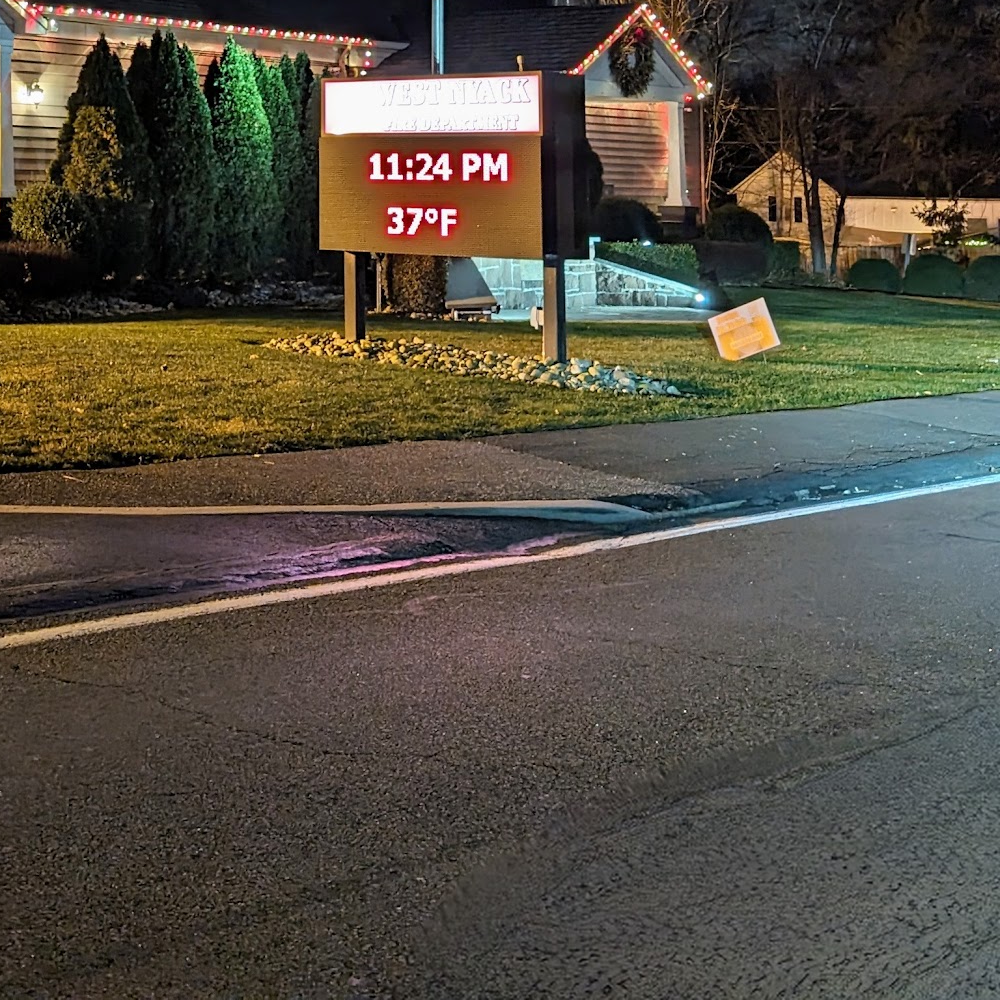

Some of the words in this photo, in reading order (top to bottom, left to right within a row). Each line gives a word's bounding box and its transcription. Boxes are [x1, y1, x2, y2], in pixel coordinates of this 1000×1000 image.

[448, 78, 531, 104] NYACK
[369, 153, 453, 181] 11:24
[462, 153, 508, 182] PM
[387, 206, 457, 237] 37°F
